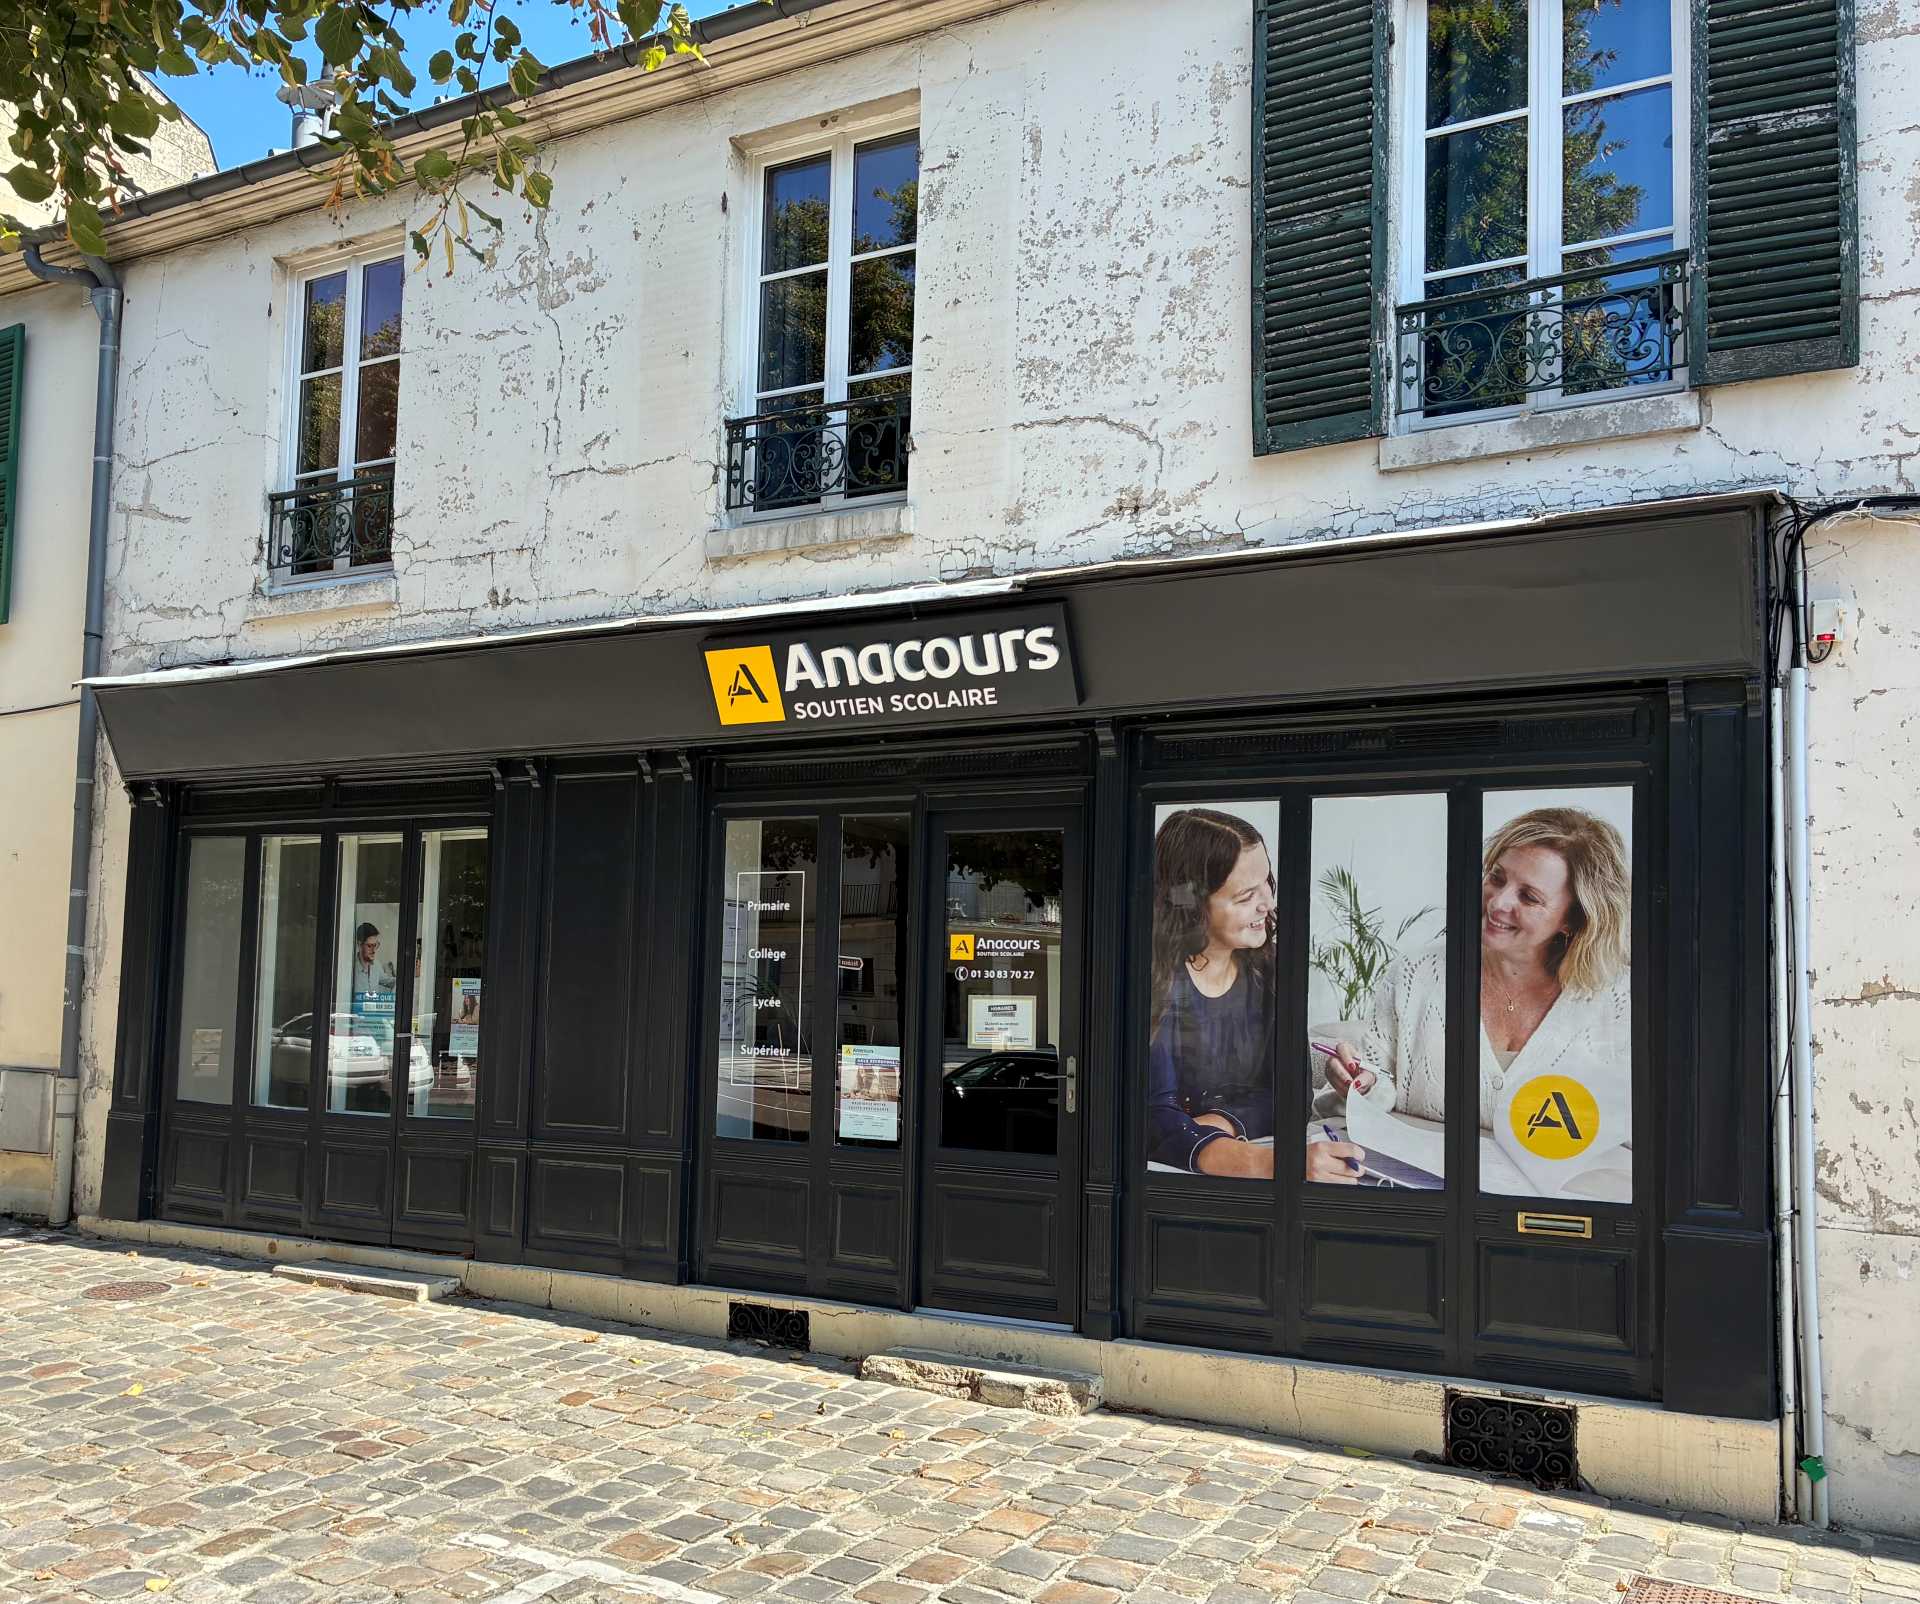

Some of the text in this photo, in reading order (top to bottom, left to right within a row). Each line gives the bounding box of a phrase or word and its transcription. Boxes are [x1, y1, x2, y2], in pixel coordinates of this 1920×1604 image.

[785, 626, 1060, 692] Anacours
[794, 687, 998, 720] SOUTIEN SCOLAIRE
[747, 900, 790, 911] Primaire
[976, 937, 1041, 950] Anacours
[748, 948, 786, 961] Collège
[970, 969, 1035, 979] 01 30 83 70 27
[752, 996, 781, 1008] Lycée
[740, 1044, 791, 1057] Supérieur
